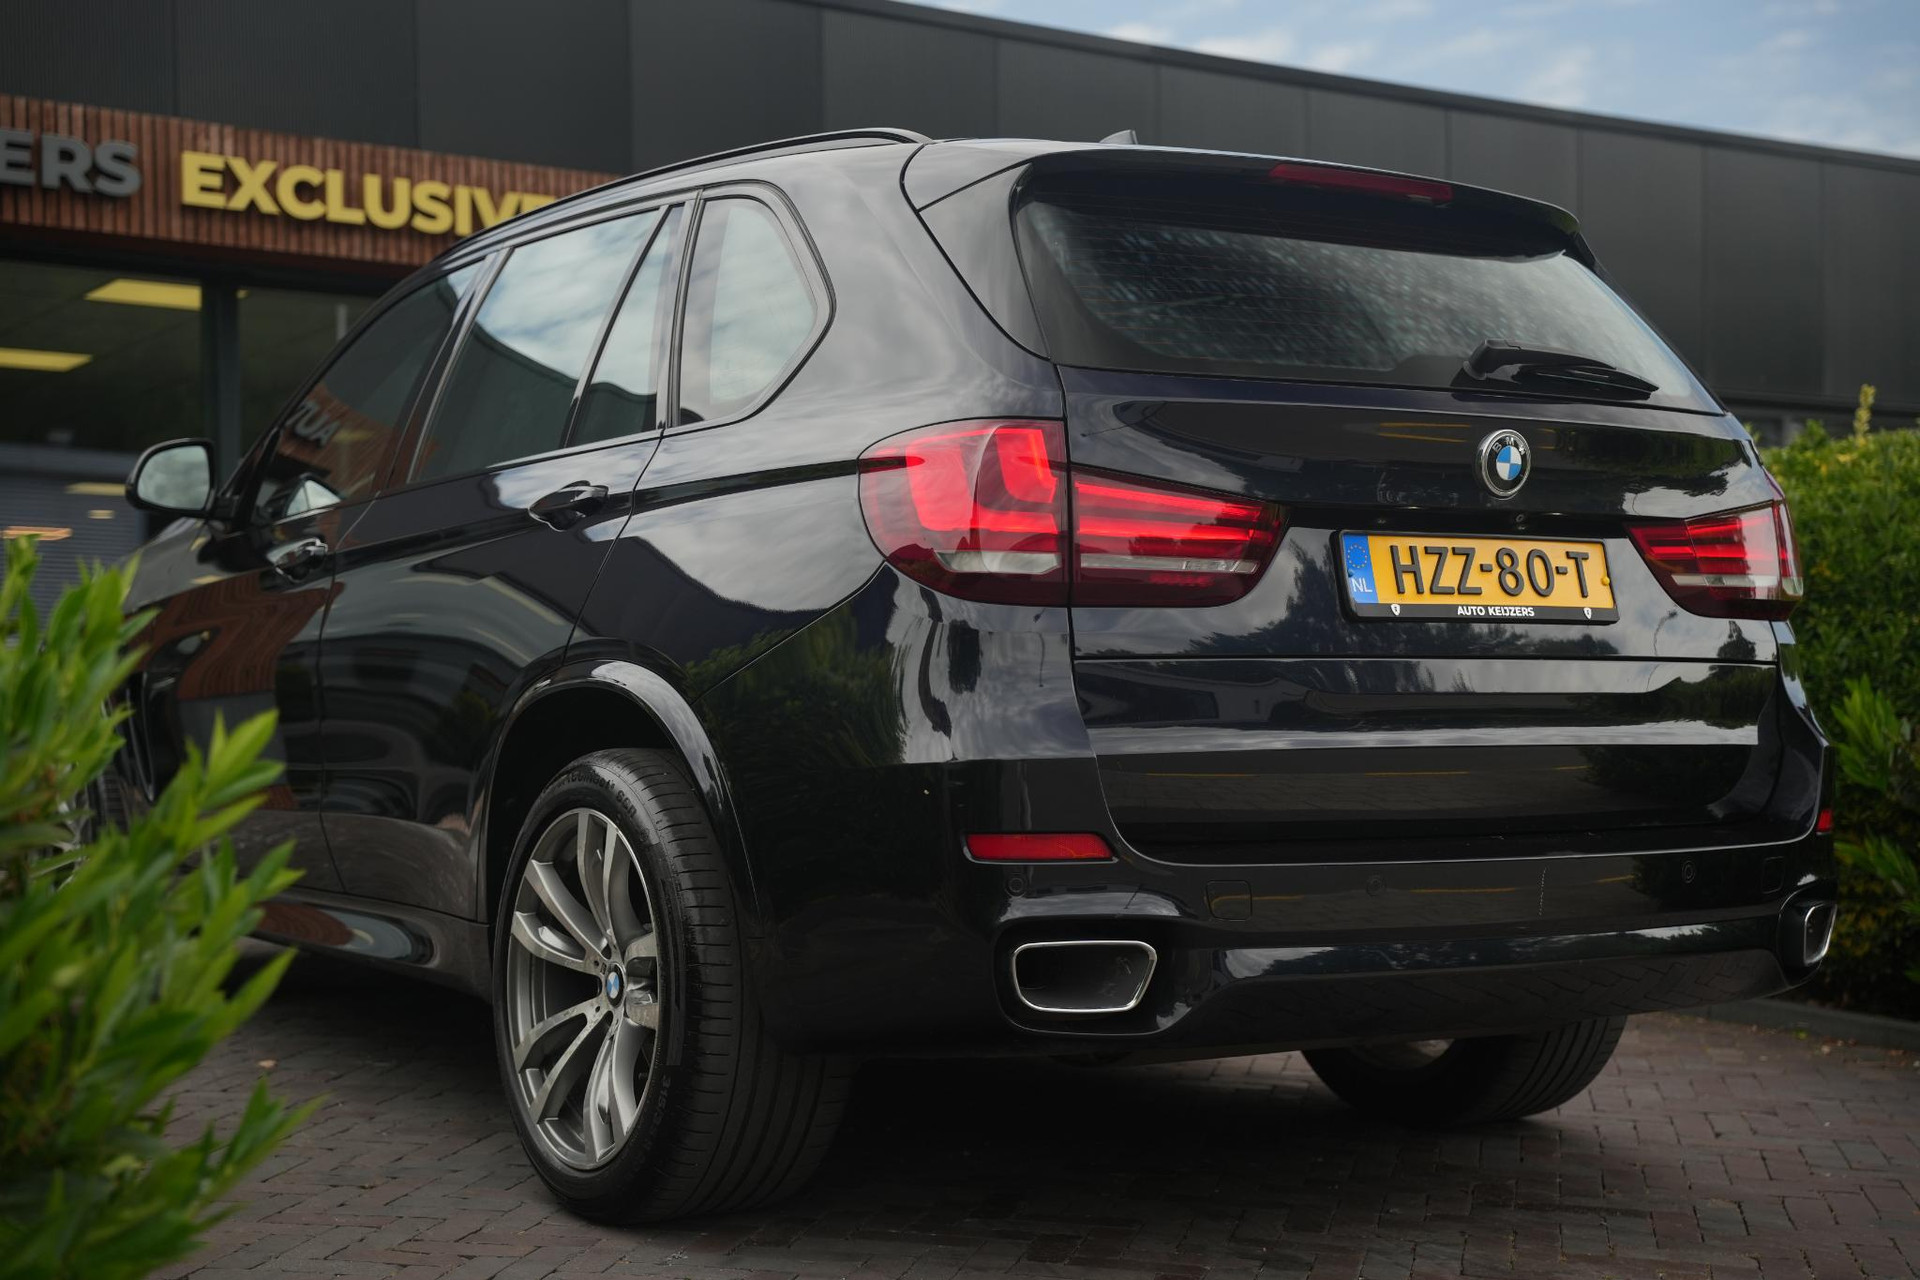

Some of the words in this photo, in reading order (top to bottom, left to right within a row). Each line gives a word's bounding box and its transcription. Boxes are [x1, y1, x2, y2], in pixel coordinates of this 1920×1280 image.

[1389, 544, 1590, 599] HZZ-80-T
[1352, 577, 1373, 593] NL
[1457, 605, 1486, 616] AUTO
[1487, 606, 1535, 617] KEIJZERS
